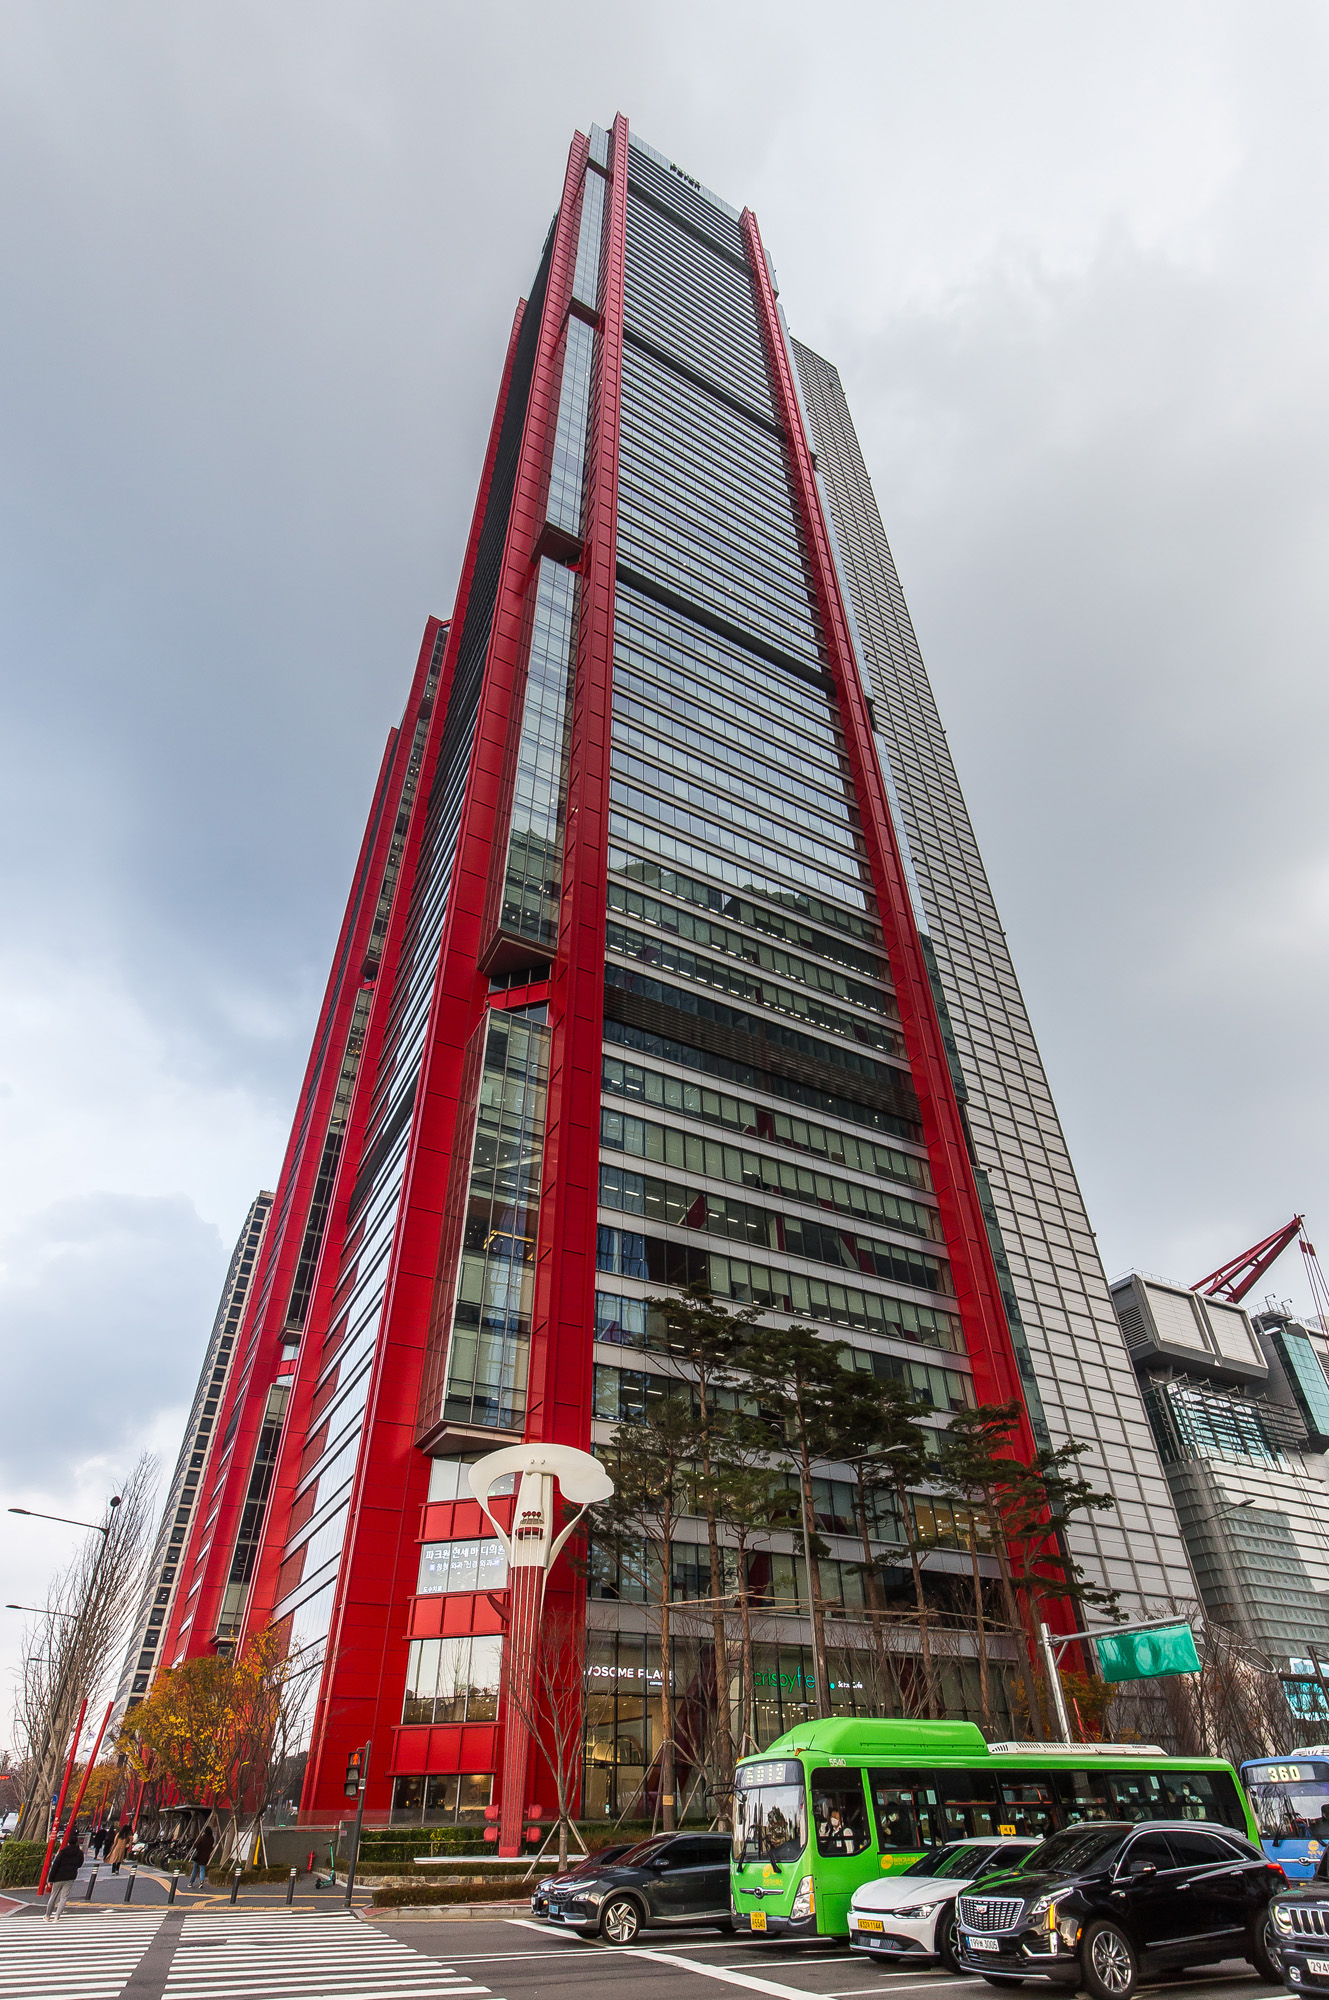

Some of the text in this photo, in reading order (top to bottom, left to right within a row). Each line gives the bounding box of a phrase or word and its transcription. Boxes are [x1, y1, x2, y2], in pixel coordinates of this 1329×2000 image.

[828, 1759, 847, 1767] 5540
[1268, 1766, 1300, 1782] 360
[1311, 1961, 1329, 1974] 294
